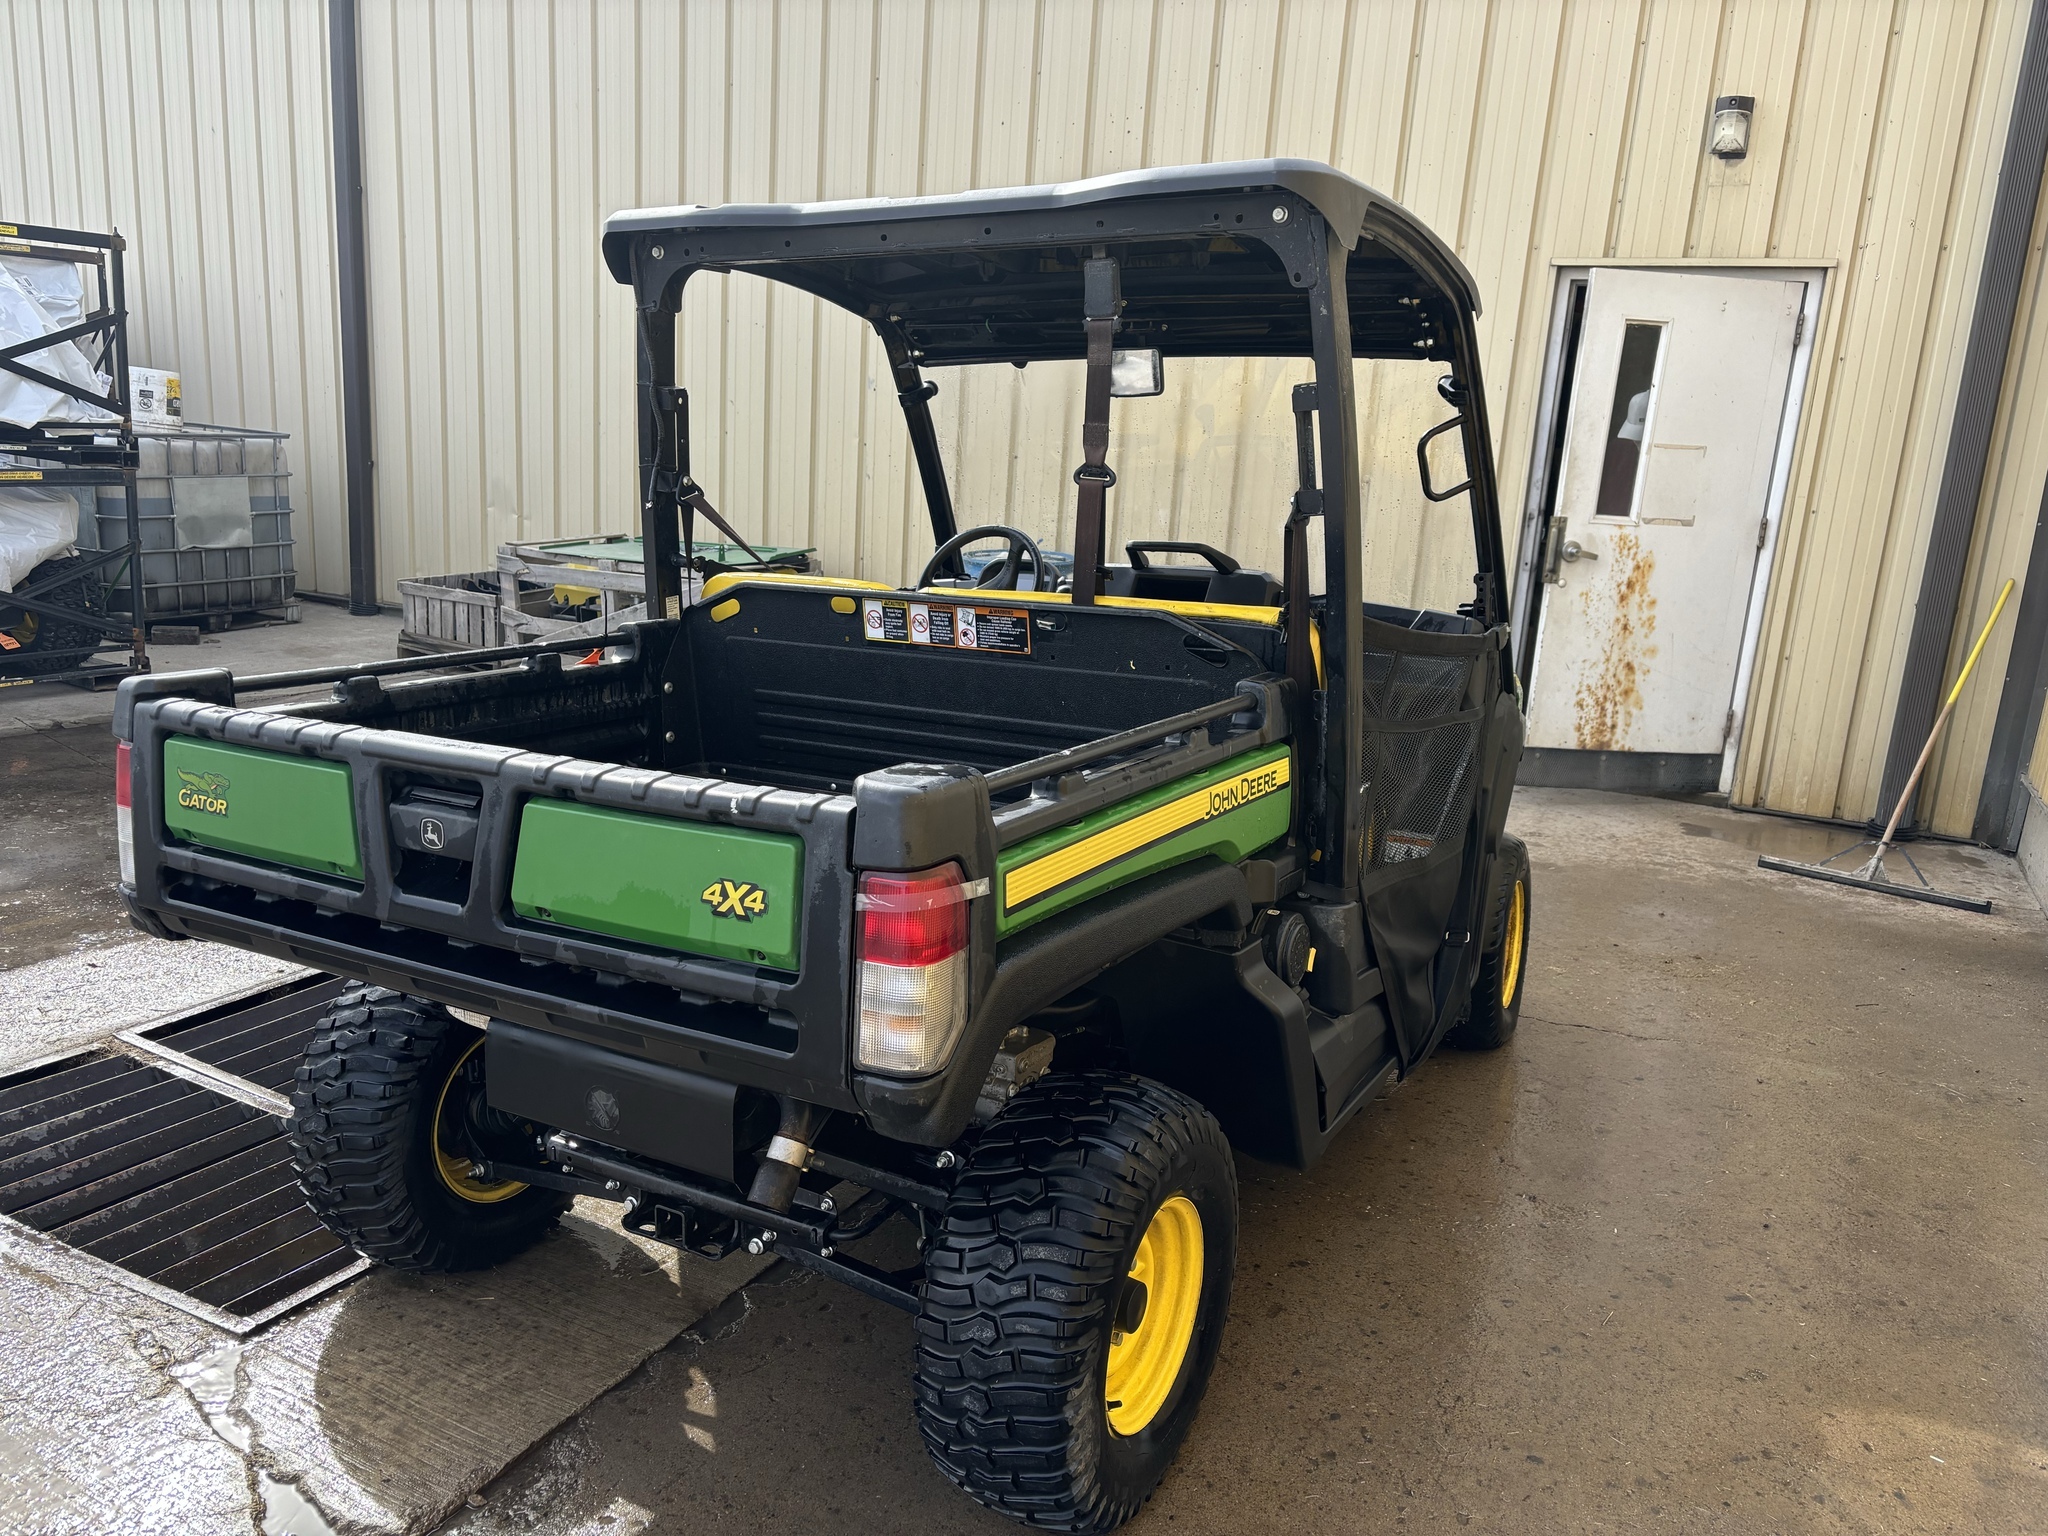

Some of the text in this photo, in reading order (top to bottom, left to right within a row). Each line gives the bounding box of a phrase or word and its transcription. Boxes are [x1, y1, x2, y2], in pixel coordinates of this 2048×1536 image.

[178, 788, 227, 815] GATOR
[1205, 769, 1278, 817] JOHN DEERE
[702, 880, 765, 916] 4X4
